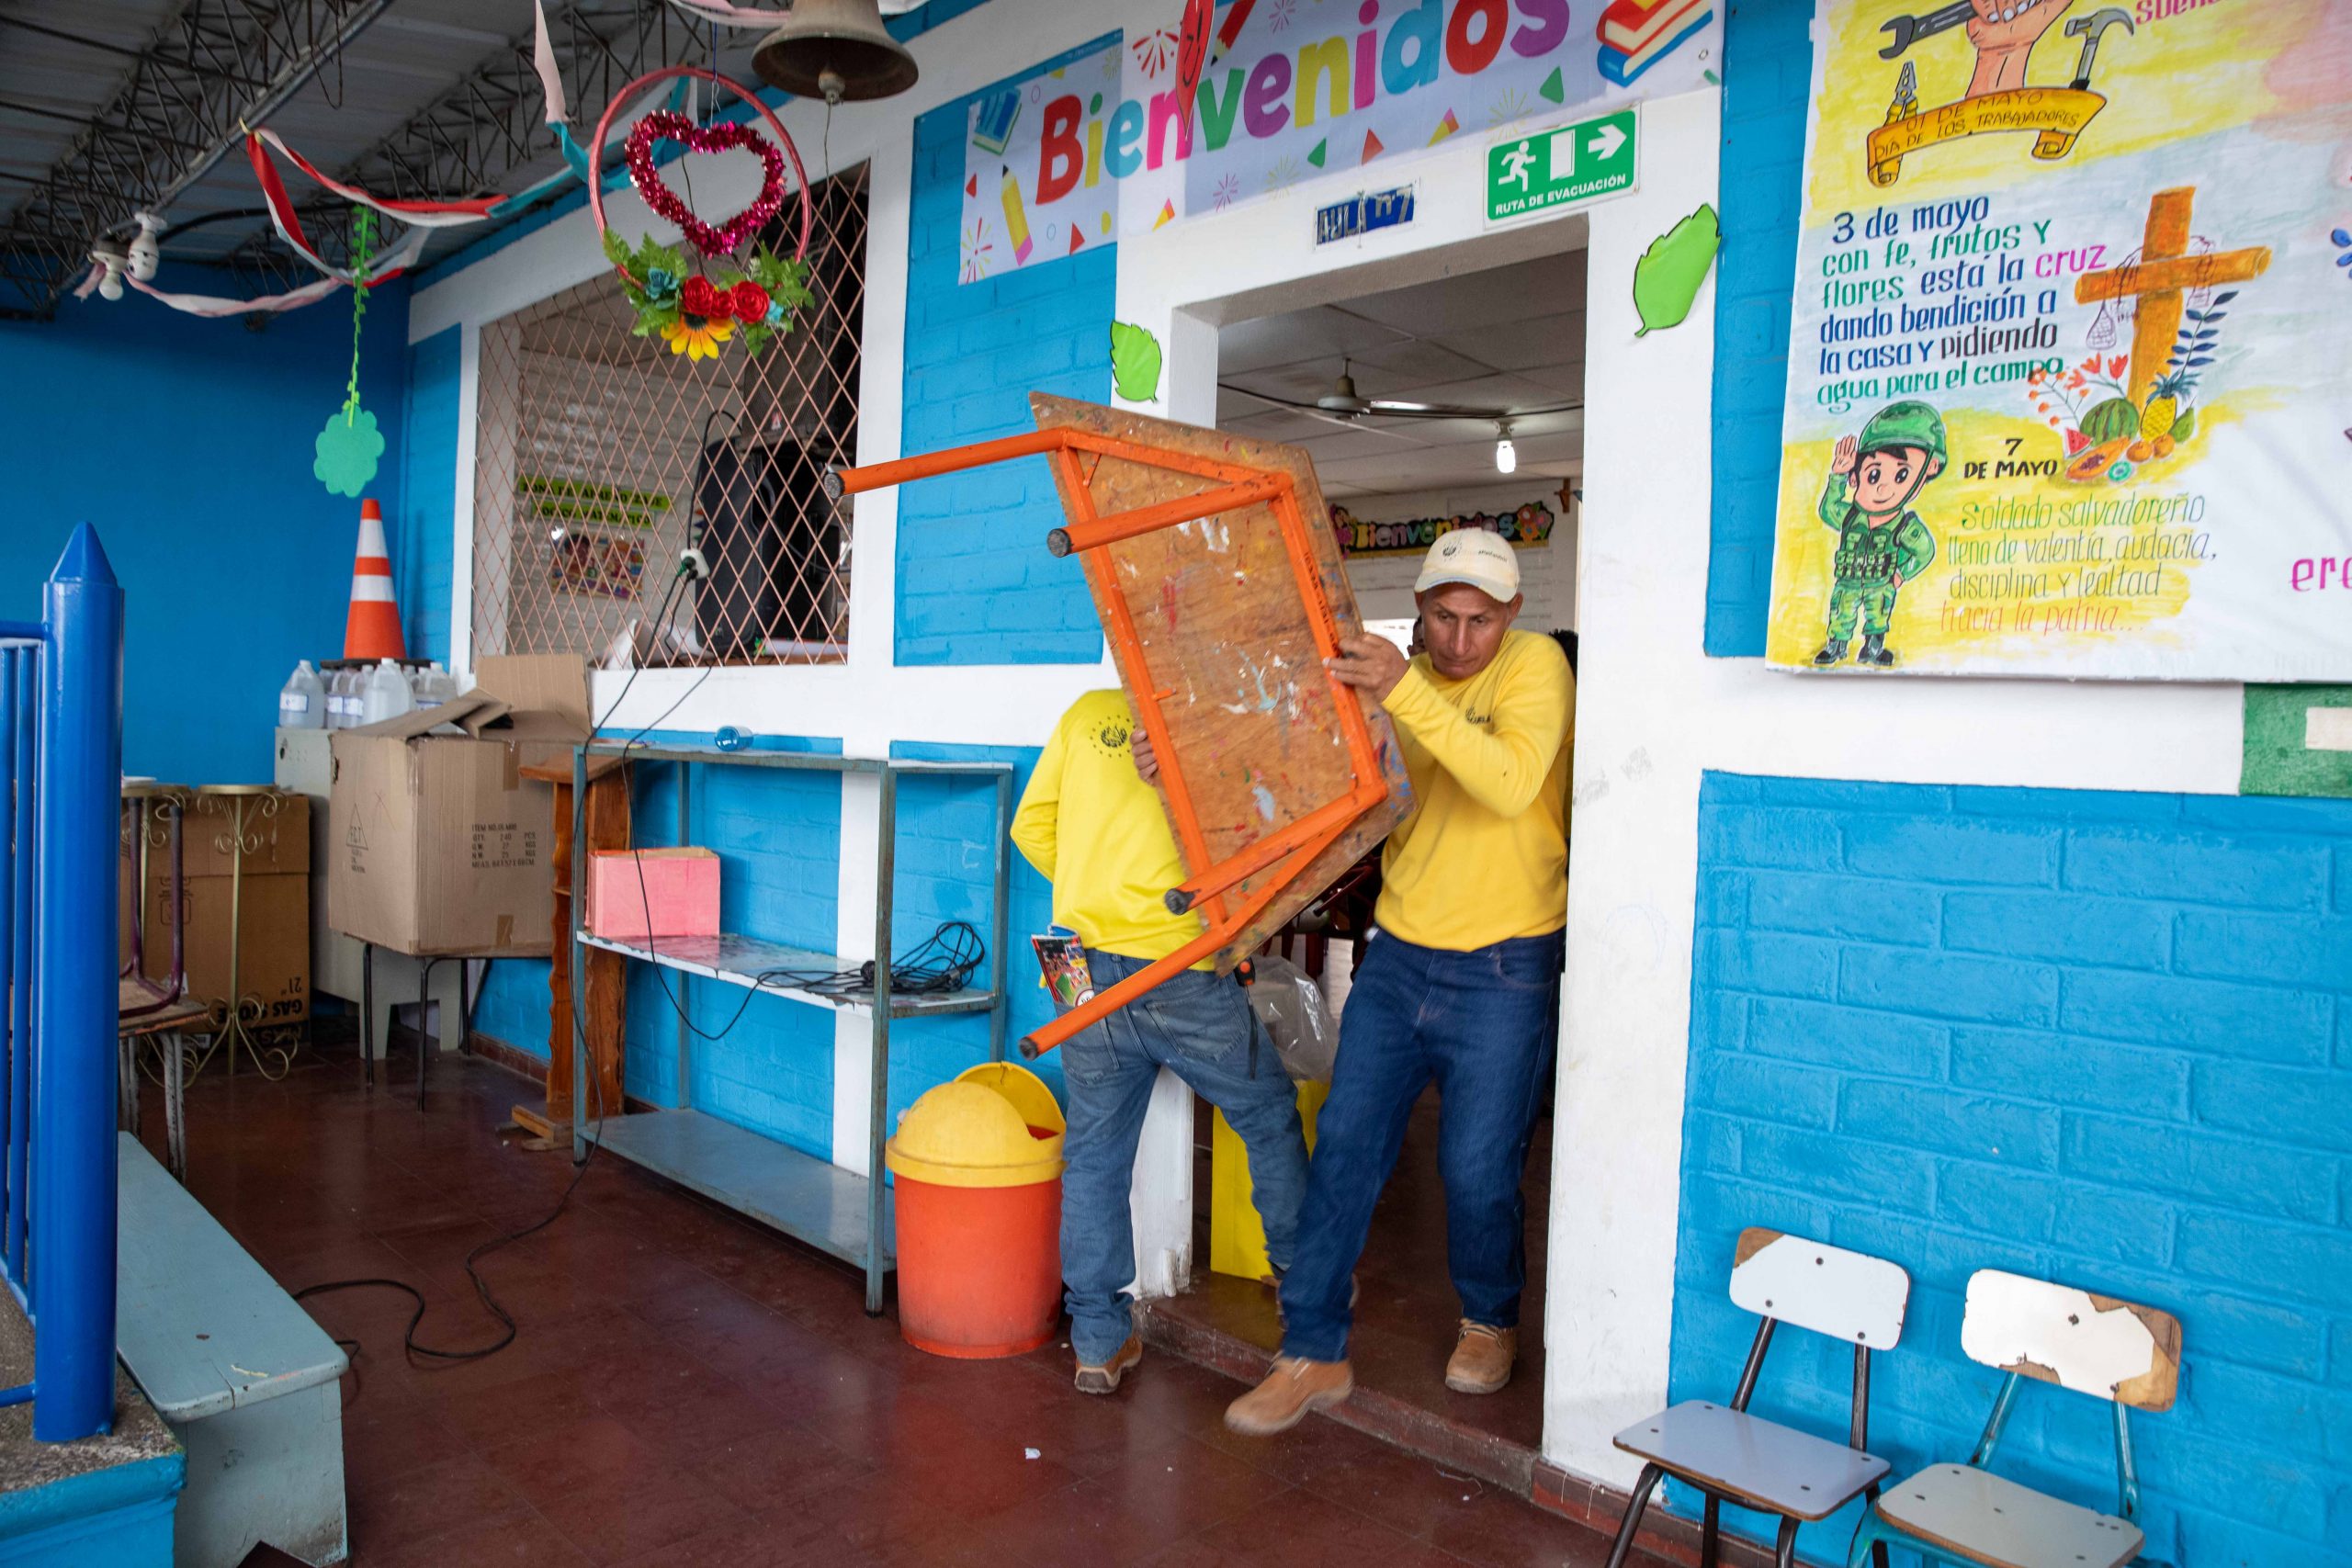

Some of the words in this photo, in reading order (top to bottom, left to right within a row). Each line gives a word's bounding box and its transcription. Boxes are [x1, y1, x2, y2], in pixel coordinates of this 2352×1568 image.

[1035, 0, 1570, 206] Bienvenidos
[1938, 105, 1965, 124] DE
[1976, 92, 2043, 110] MAYO
[1906, 133, 1924, 146] DE
[1938, 118, 1966, 139] LOS
[1495, 197, 1526, 216] RUTA
[1529, 192, 1544, 207] DE
[1547, 173, 1626, 202] EVACUACIÓN
[1832, 211, 1855, 244] 3
[1865, 208, 1898, 240] de
[1912, 196, 1989, 237] mayo
[1823, 249, 1869, 277] con
[1885, 239, 1916, 269] fe,
[1930, 223, 2021, 260] frutos
[1823, 275, 1904, 309] flores
[1921, 254, 1990, 295] está
[1998, 254, 2024, 285] la
[2035, 244, 2107, 278] cruz
[1820, 307, 1893, 344] dando
[1900, 287, 2025, 333] bendición
[2038, 288, 2056, 314] a
[1820, 347, 1839, 375] la
[1848, 341, 1911, 371] casa
[1940, 317, 2058, 359] pidiendo
[1817, 380, 1880, 413] agua
[1886, 369, 1939, 399] para
[1945, 360, 1967, 388] el
[1973, 356, 2064, 385] campo
[2005, 438, 2024, 457] 7
[1963, 461, 1988, 479] DE
[1995, 459, 2058, 479] MAYO
[1962, 494, 2052, 531] Soldado
[2058, 491, 2207, 529] salvadoreño
[1948, 535, 1990, 566] lleno
[1996, 532, 2018, 564] de
[2115, 526, 2218, 561] audacia,
[1949, 568, 2049, 601] disciplina
[2077, 562, 2162, 597] lealtad
[1940, 600, 2004, 633] hacia
[2013, 600, 2034, 632] la
[273, 999, 303, 1017] GAS
